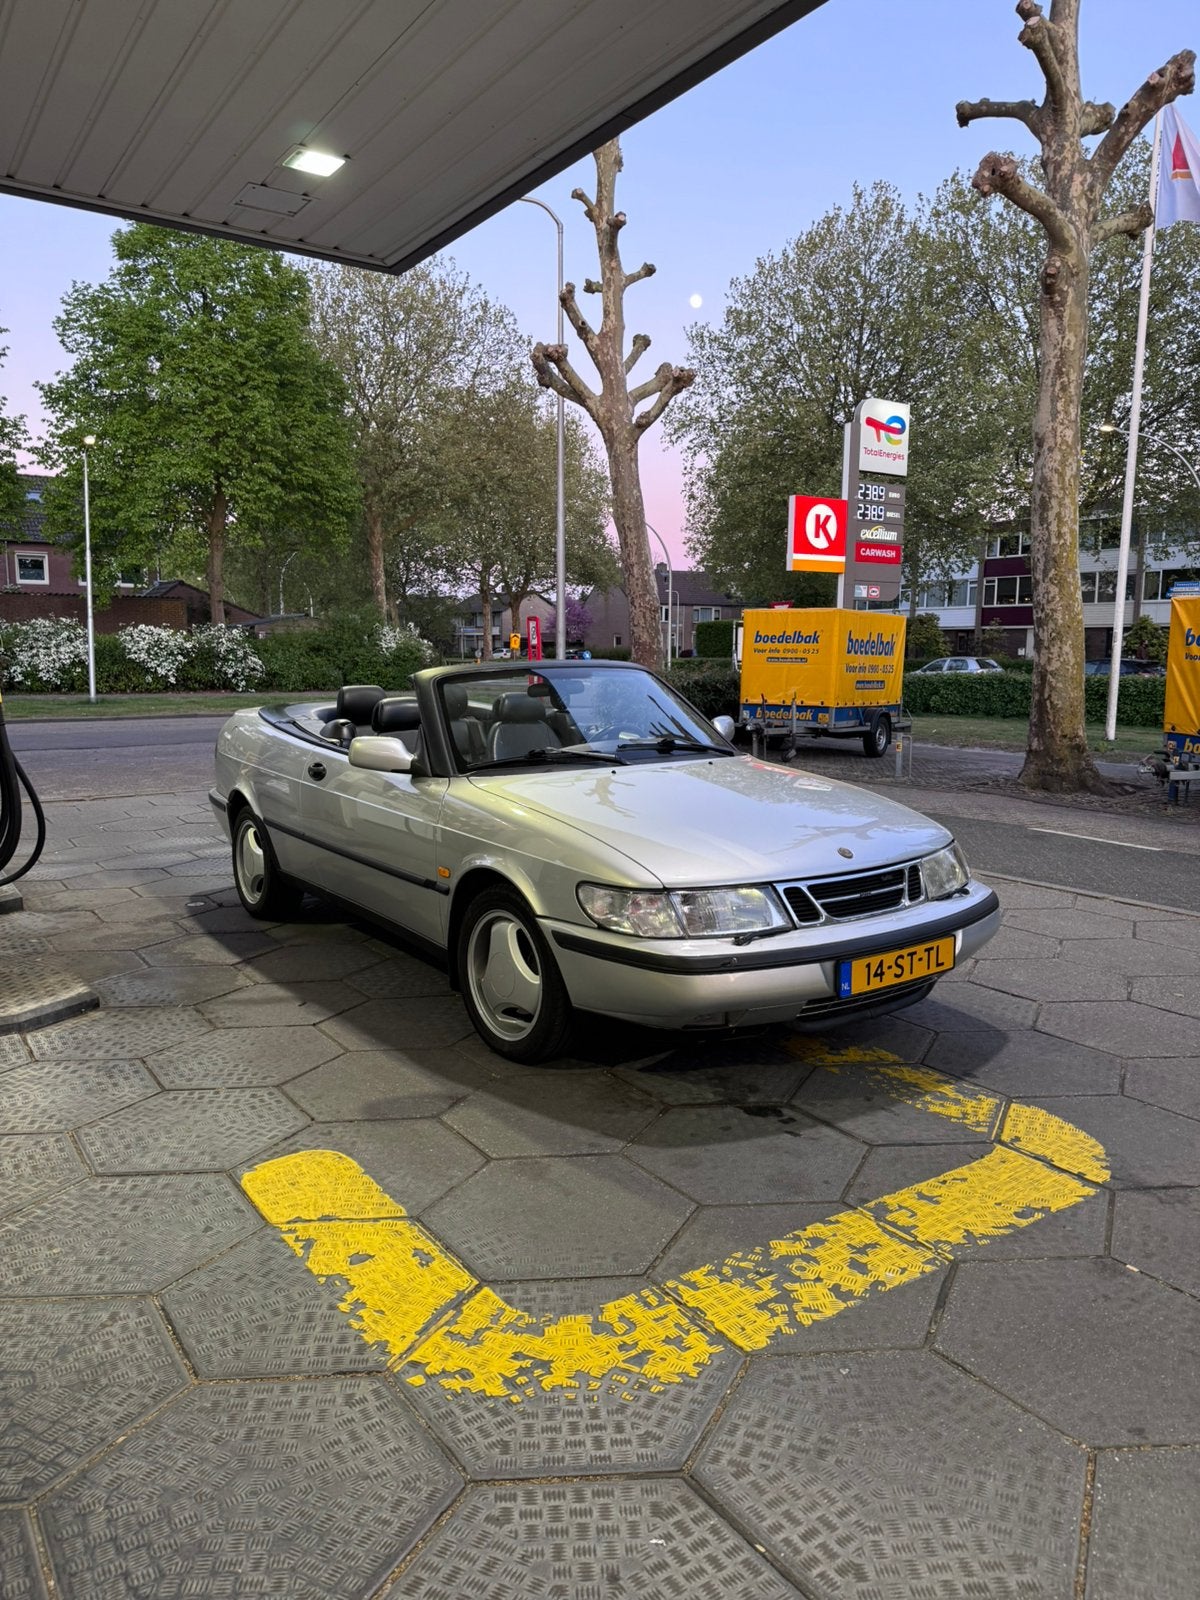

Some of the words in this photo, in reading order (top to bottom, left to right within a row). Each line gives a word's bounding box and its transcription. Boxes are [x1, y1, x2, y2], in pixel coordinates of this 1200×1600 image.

[863, 446, 905, 461] TotalEnergies
[860, 528, 897, 541] excellium
[860, 547, 896, 558] CARWASH
[754, 630, 820, 644] boedelbak
[846, 630, 896, 656] boedelbak
[768, 646, 780, 654] info
[845, 663, 857, 673] Voor
[865, 945, 944, 986] 14-ST-TL
[841, 981, 850, 991] NL
